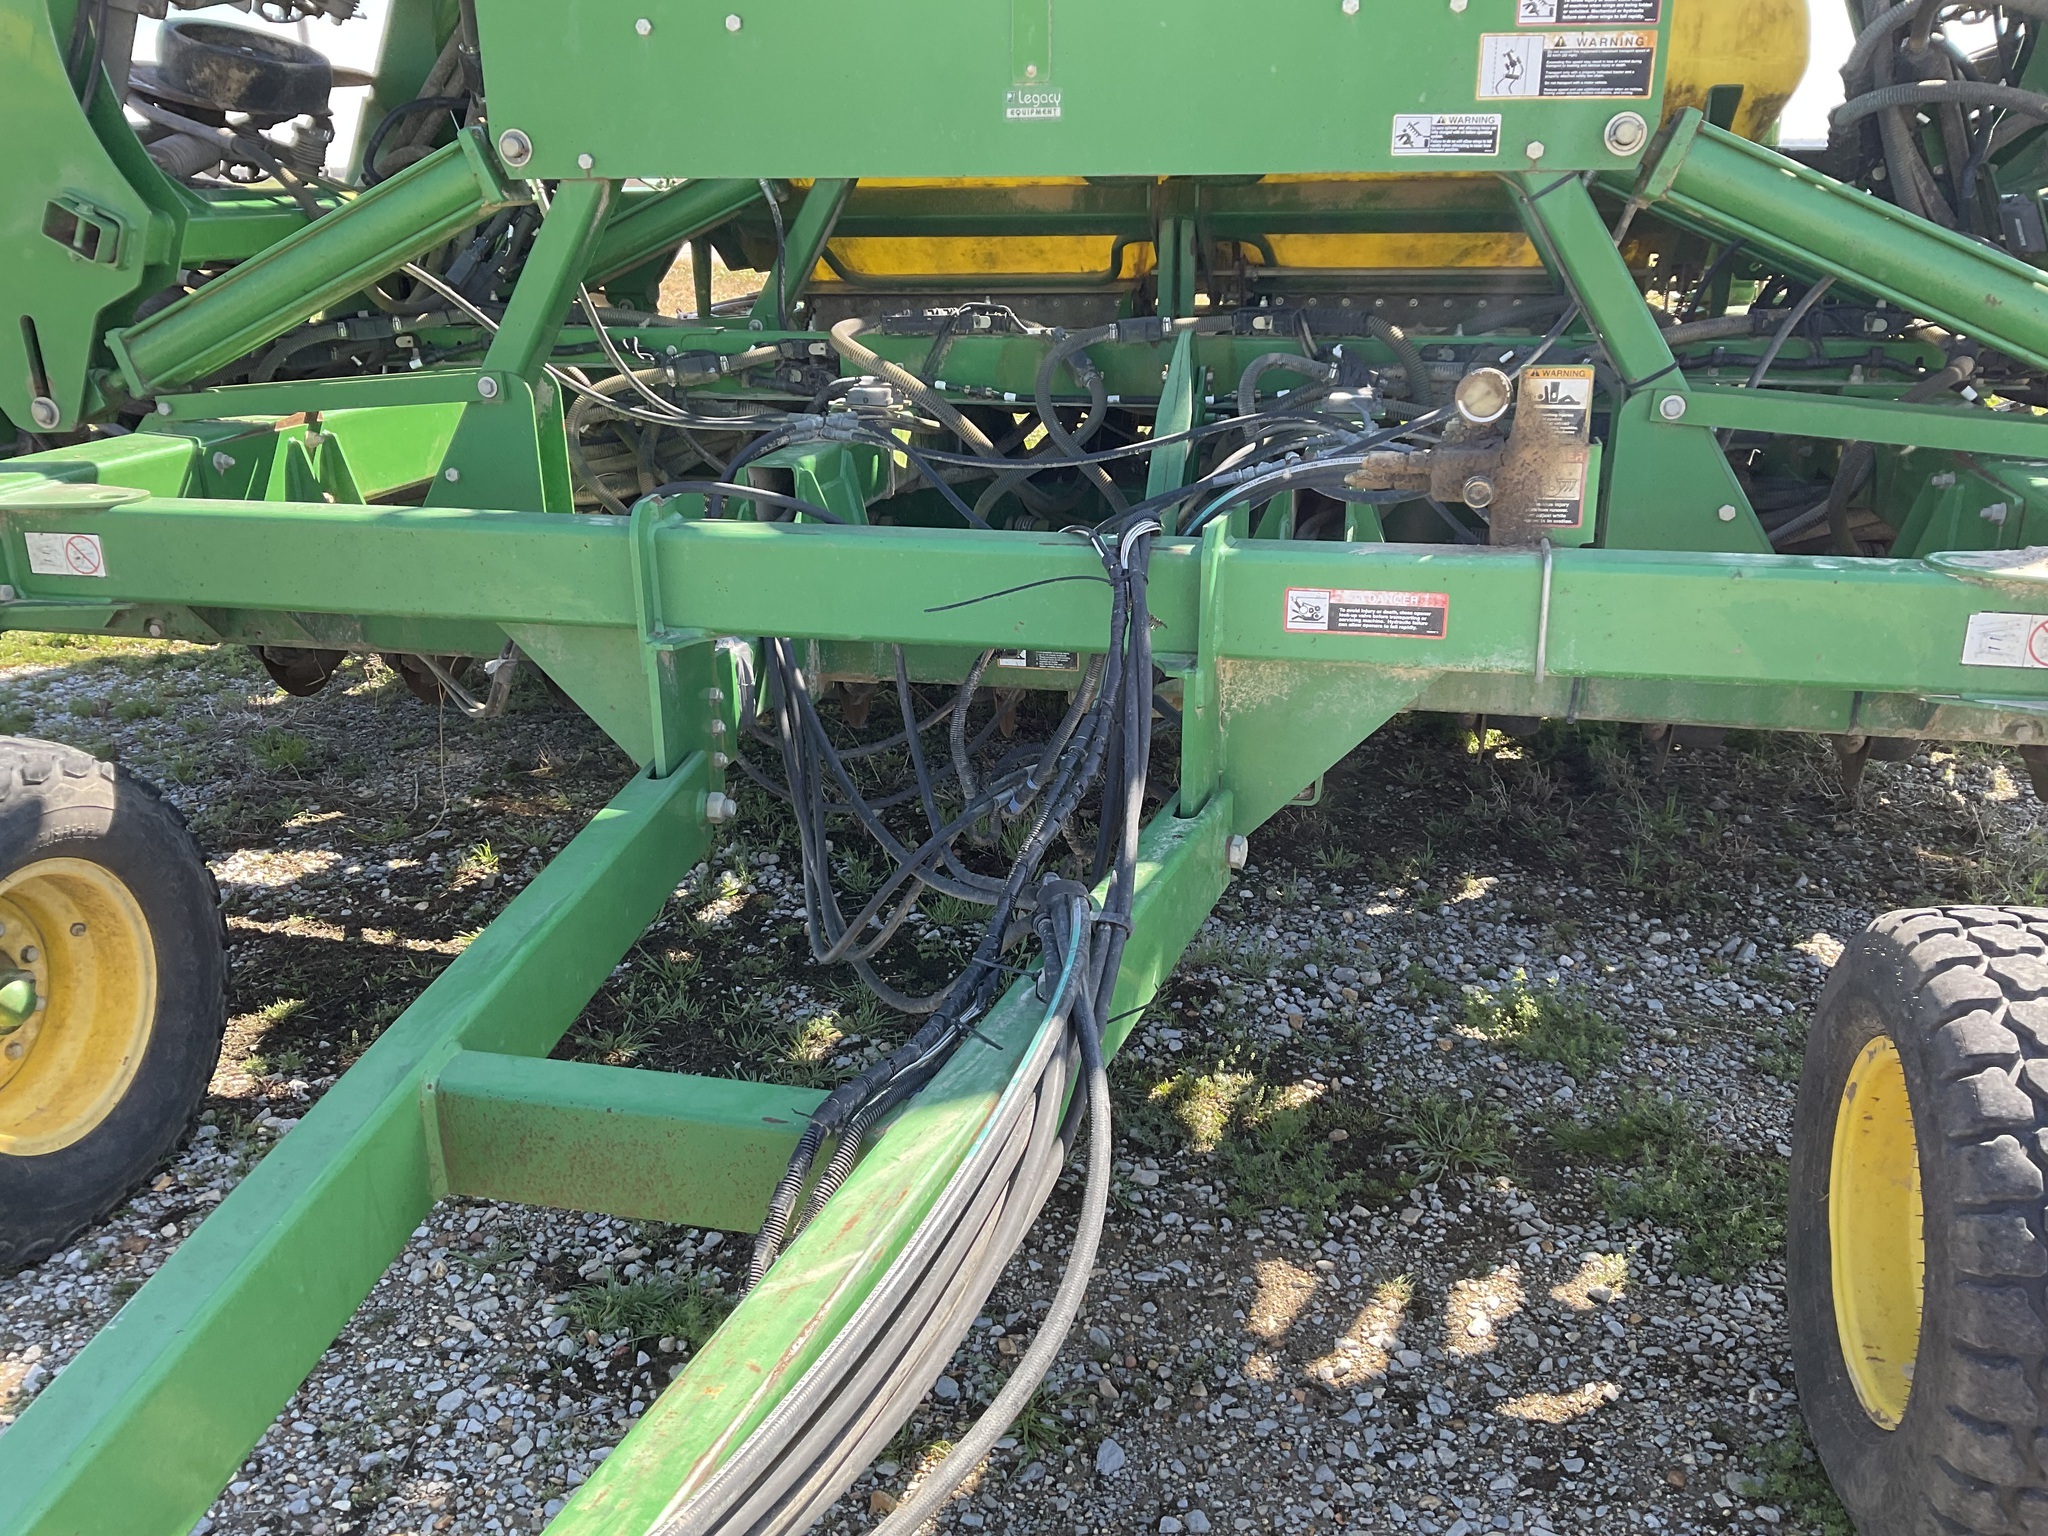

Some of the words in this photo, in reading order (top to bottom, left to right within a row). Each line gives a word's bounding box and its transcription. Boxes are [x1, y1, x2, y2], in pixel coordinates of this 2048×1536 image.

[1577, 36, 1644, 46] WARNING
[1018, 91, 1060, 107] Legacy
[1370, 595, 1418, 604] DANGER
